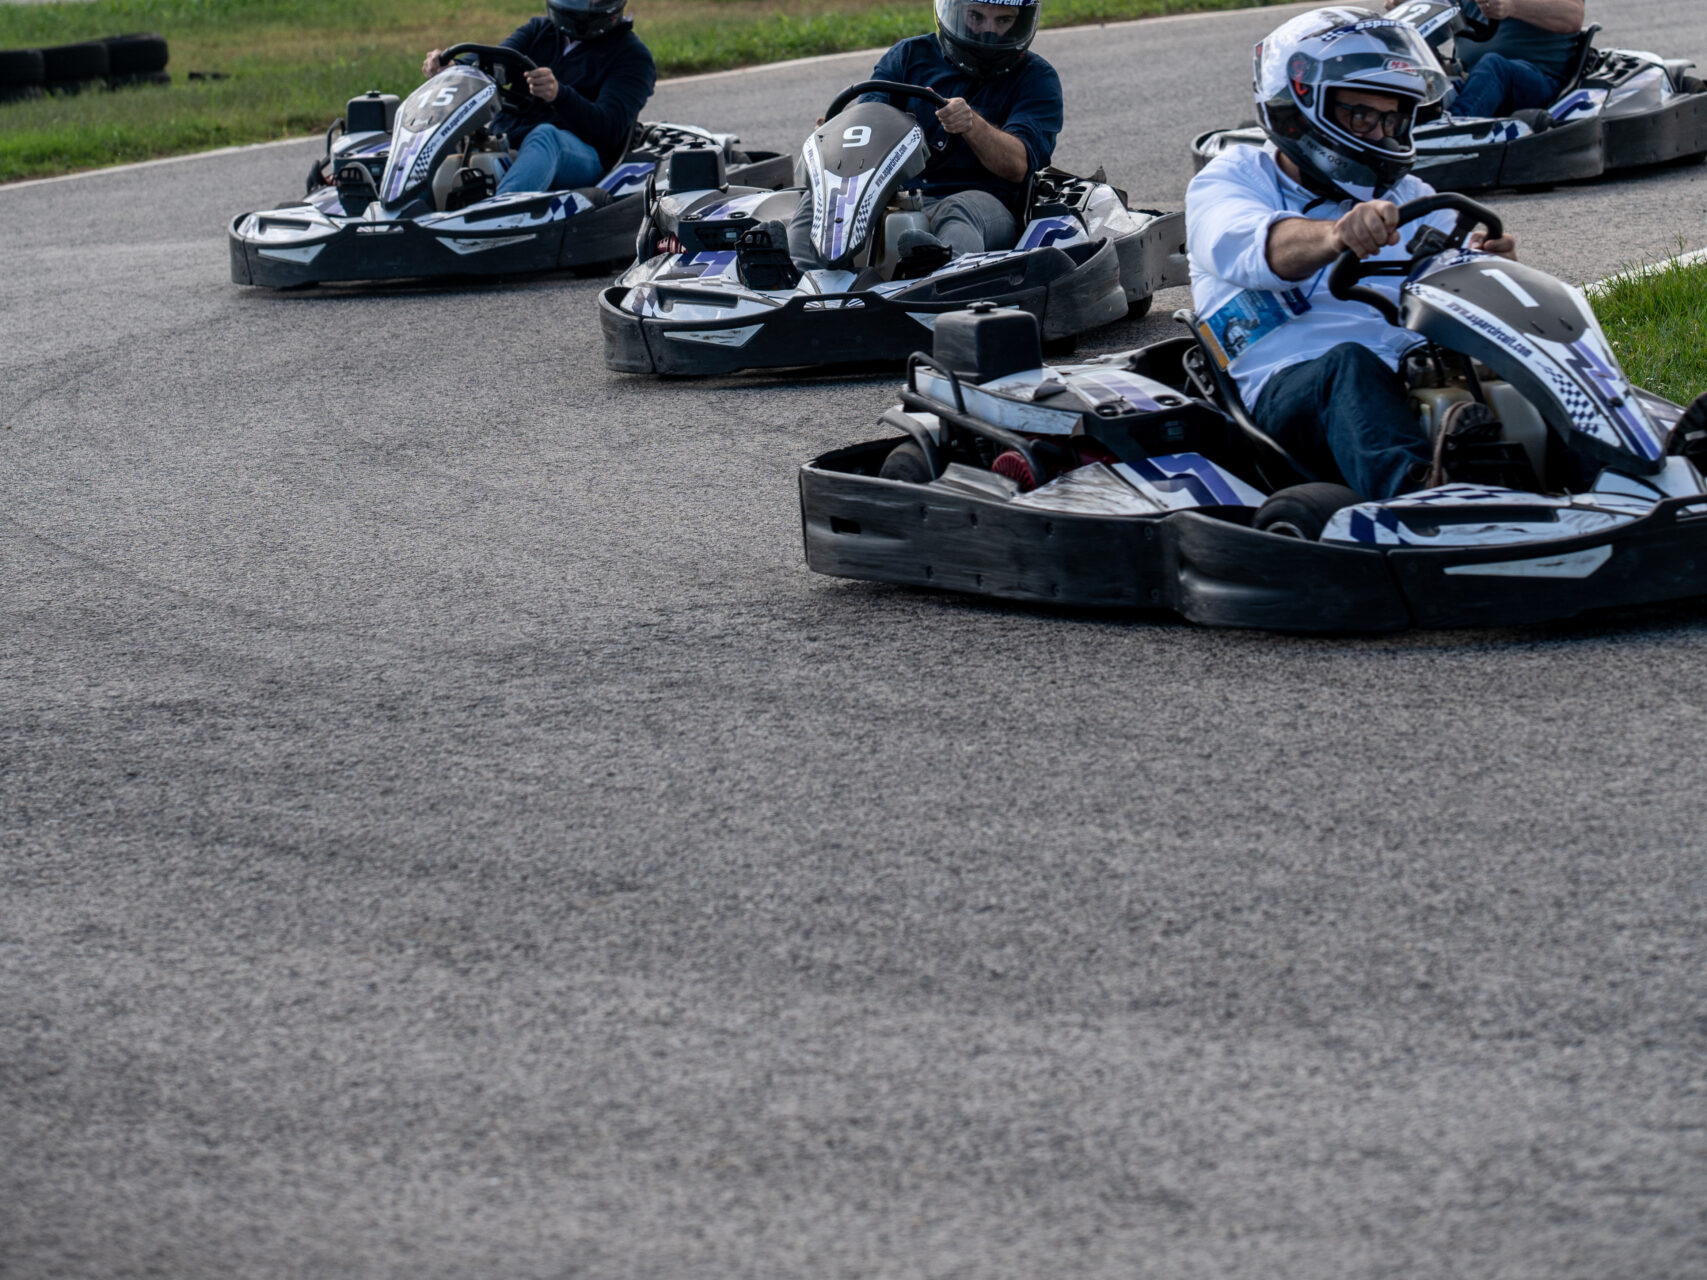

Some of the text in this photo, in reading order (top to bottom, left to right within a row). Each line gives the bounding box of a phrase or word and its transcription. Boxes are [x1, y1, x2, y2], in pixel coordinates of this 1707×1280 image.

[418, 87, 458, 108] 15
[842, 125, 872, 148] 9
[1480, 269, 1540, 307] 1
[1446, 301, 1533, 358] www.asparcircuit.com
